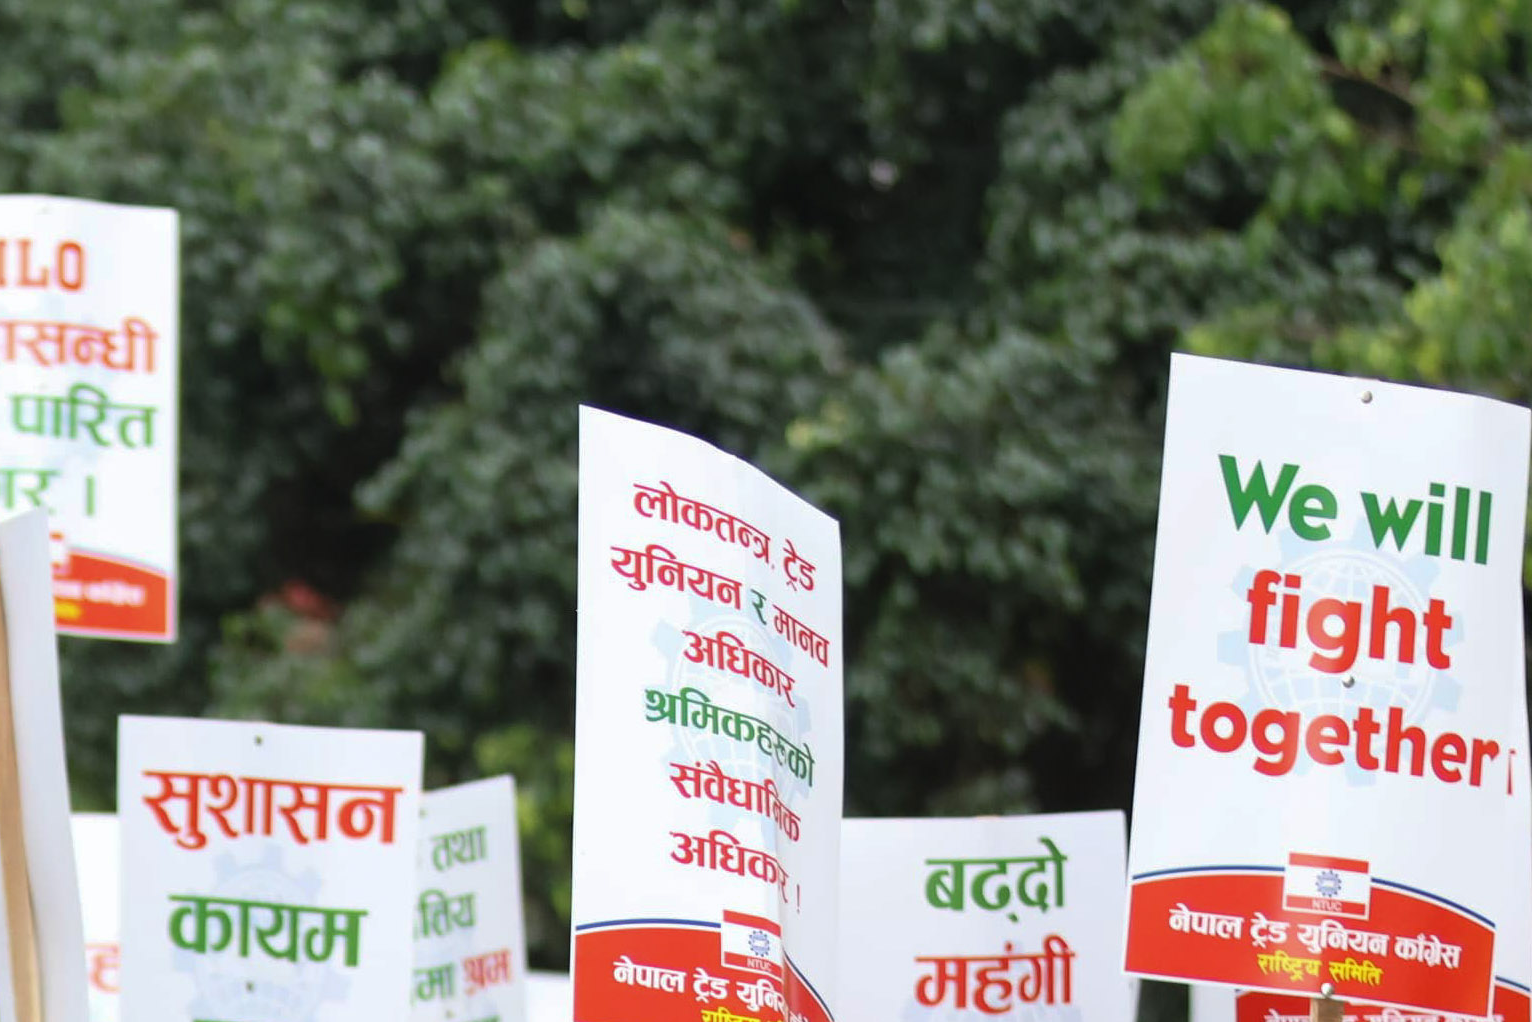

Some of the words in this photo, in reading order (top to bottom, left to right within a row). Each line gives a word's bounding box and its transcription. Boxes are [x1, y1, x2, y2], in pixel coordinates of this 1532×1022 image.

[11, 381, 157, 449] पारित
[1219, 454, 1338, 542] We
[1361, 482, 1494, 566] will
[782, 537, 817, 593] ट्रेड
[610, 543, 743, 611] युनियन
[749, 588, 769, 626] र
[772, 604, 831, 669] मानव
[1245, 568, 1454, 675] fight
[681, 630, 797, 708] अधिकार
[142, 770, 405, 852] सुशासन
[169, 894, 369, 967] कायम
[1168, 902, 1245, 939] नेपाल
[1250, 912, 1289, 949] ट्रेड
[1296, 918, 1390, 956] युनियन
[613, 954, 687, 993] नेपाल
[692, 967, 730, 1004] ट्रेड
[1328, 956, 1384, 985] समिति
